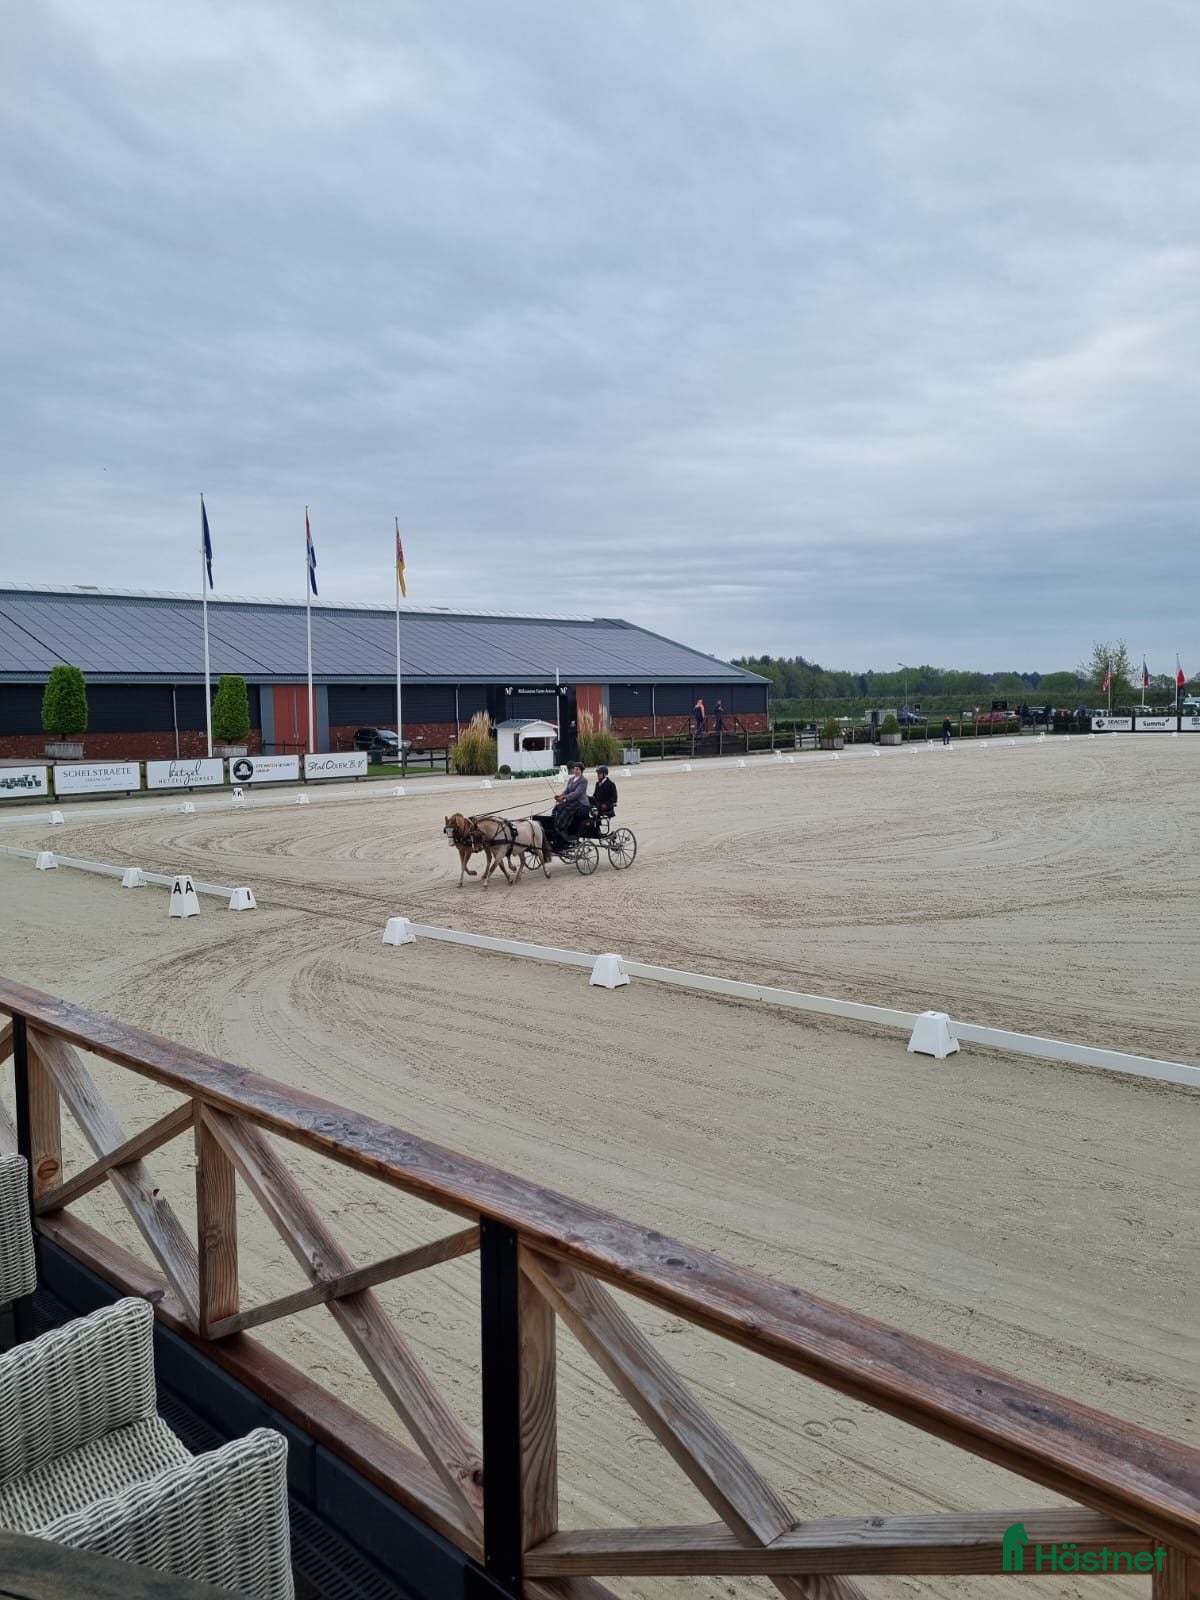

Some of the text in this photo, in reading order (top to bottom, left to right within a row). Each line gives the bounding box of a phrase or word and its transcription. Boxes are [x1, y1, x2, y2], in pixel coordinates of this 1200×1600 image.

[63, 767, 132, 778] SCHELSTRAETE
[173, 880, 194, 894] A A
